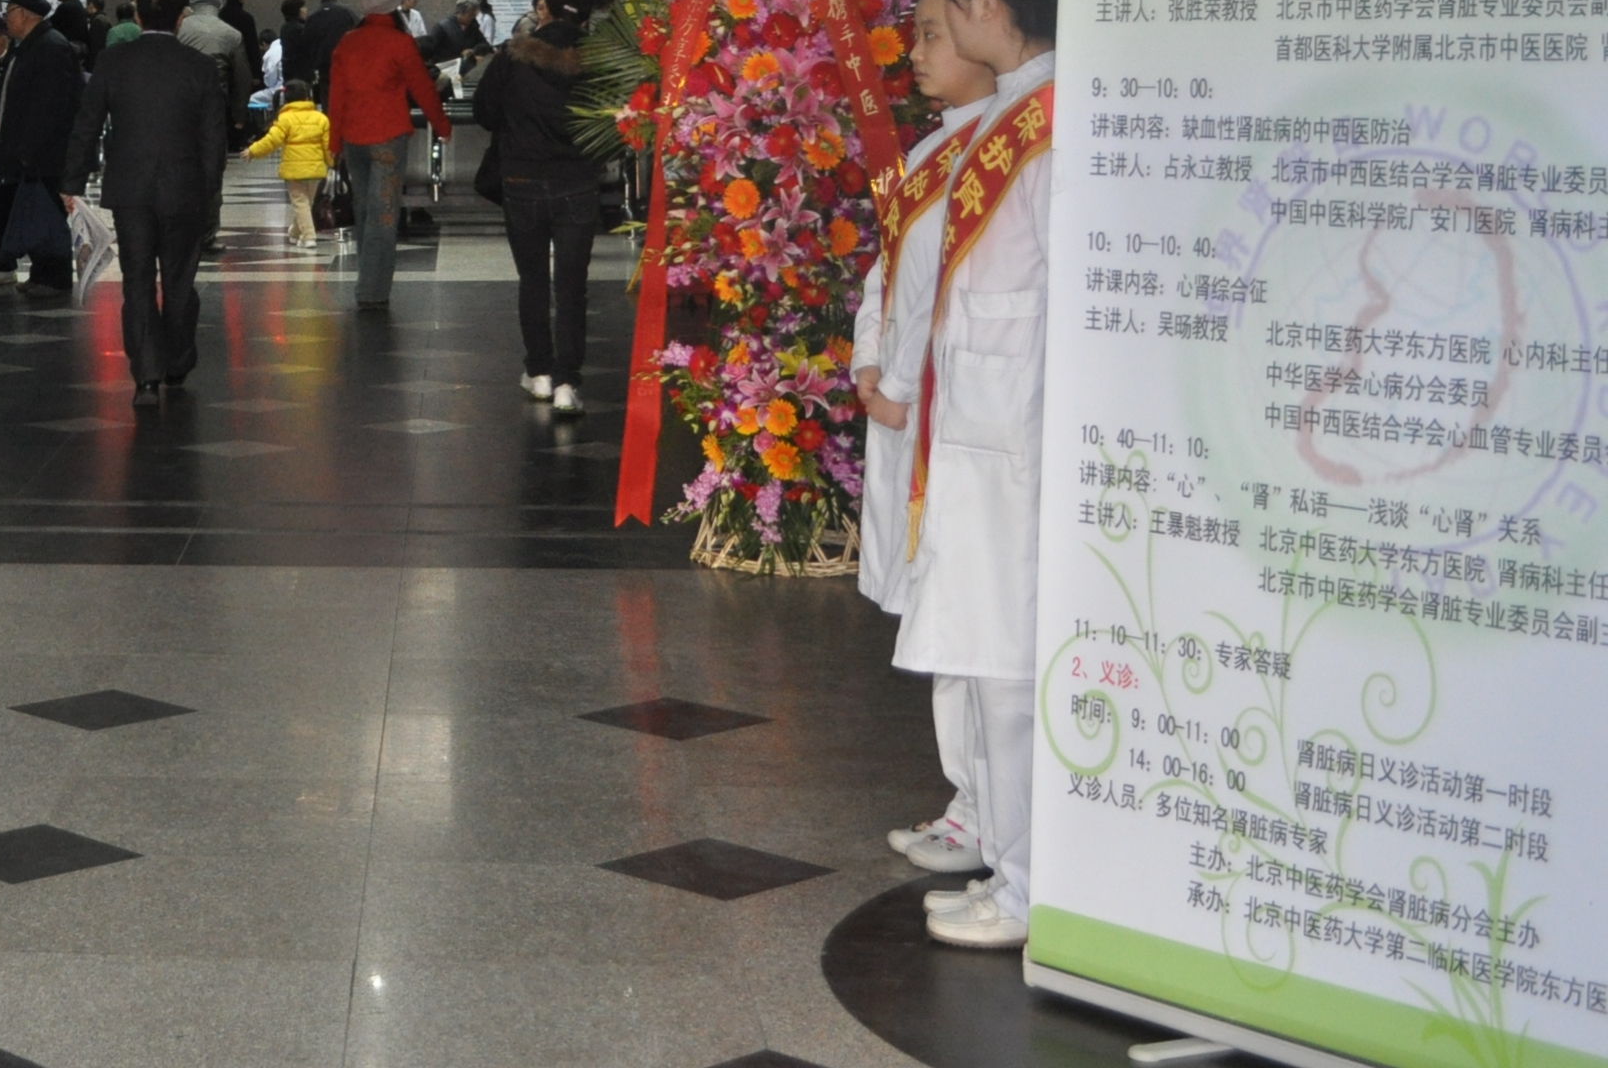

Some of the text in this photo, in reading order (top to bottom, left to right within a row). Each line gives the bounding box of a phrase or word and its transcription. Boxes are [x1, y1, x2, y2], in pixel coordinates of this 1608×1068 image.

[1275, 32, 1589, 62] 首都医科大学附属北京市中医医院
[1265, 319, 1491, 365] 北京中医药大学东方医院
[1264, 401, 1608, 466] 中国中西医结合学会心血管专业委员
[1259, 524, 1486, 584] 北京中医药大学东方医院
